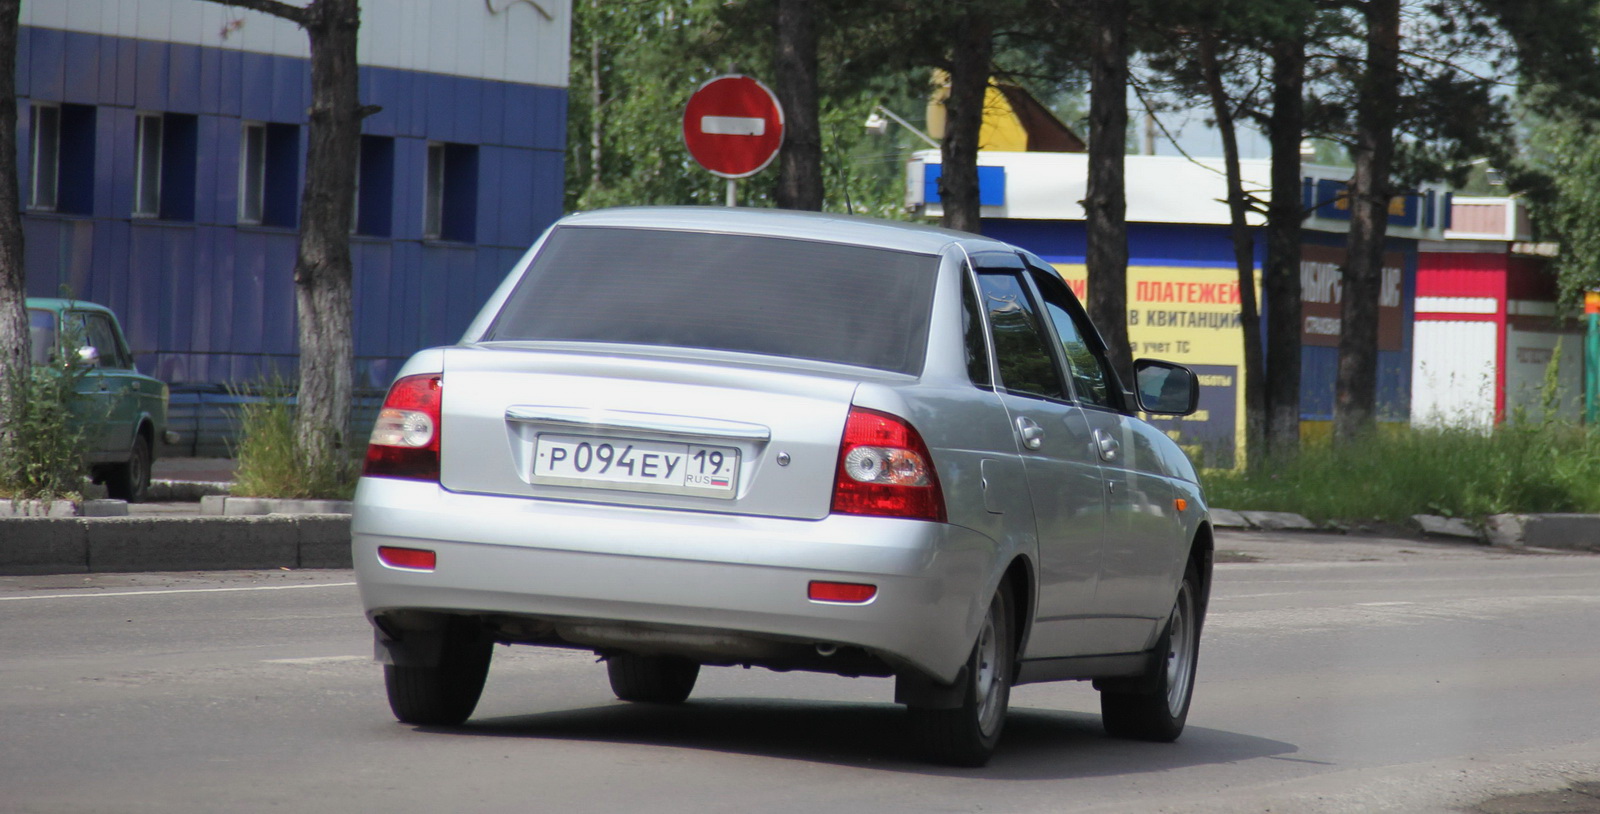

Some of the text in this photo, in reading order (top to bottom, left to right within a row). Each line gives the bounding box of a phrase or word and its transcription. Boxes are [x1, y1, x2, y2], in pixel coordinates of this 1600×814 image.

[1136, 281, 1241, 304] ПЛАТЕЖЕЙ
[1146, 310, 1242, 331] КВИТАНЦИЙ
[1143, 343, 1170, 355] учет
[1176, 341, 1191, 354] ТС
[549, 441, 724, 480] Р094ЕУ 19
[686, 474, 710, 486] RUS
